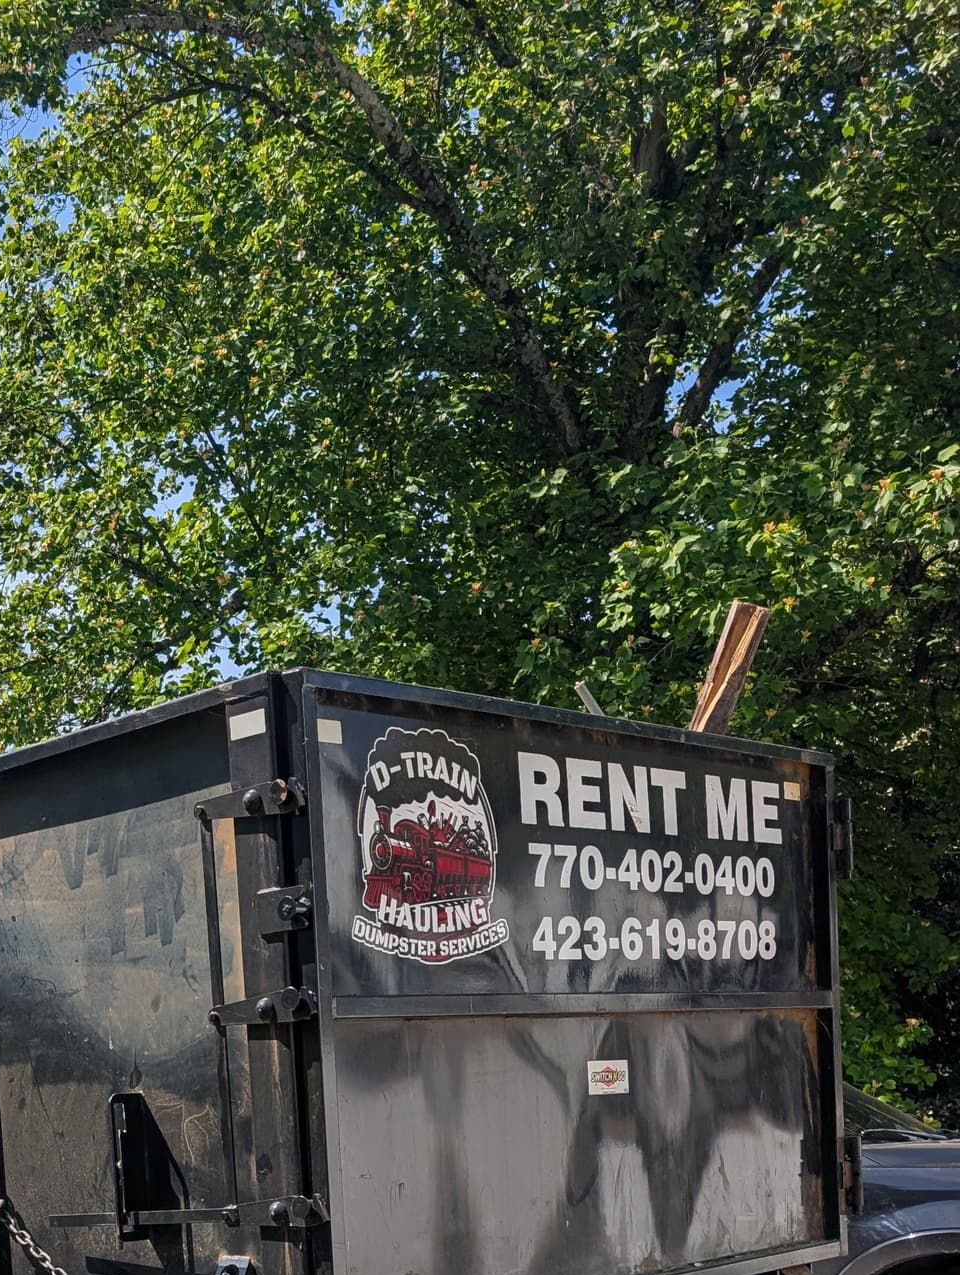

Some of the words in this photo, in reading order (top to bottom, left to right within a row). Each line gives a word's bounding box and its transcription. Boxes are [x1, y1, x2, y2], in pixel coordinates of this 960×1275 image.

[370, 751, 478, 800] D-TRAIN
[518, 751, 686, 836] RENT
[706, 775, 783, 845] ME
[528, 843, 775, 898] 770-402-0400
[378, 894, 488, 934] HAULING
[354, 920, 437, 957] DUMPSTER
[439, 922, 507, 957] SERVICES
[532, 916, 777, 961] 423-619-8708
